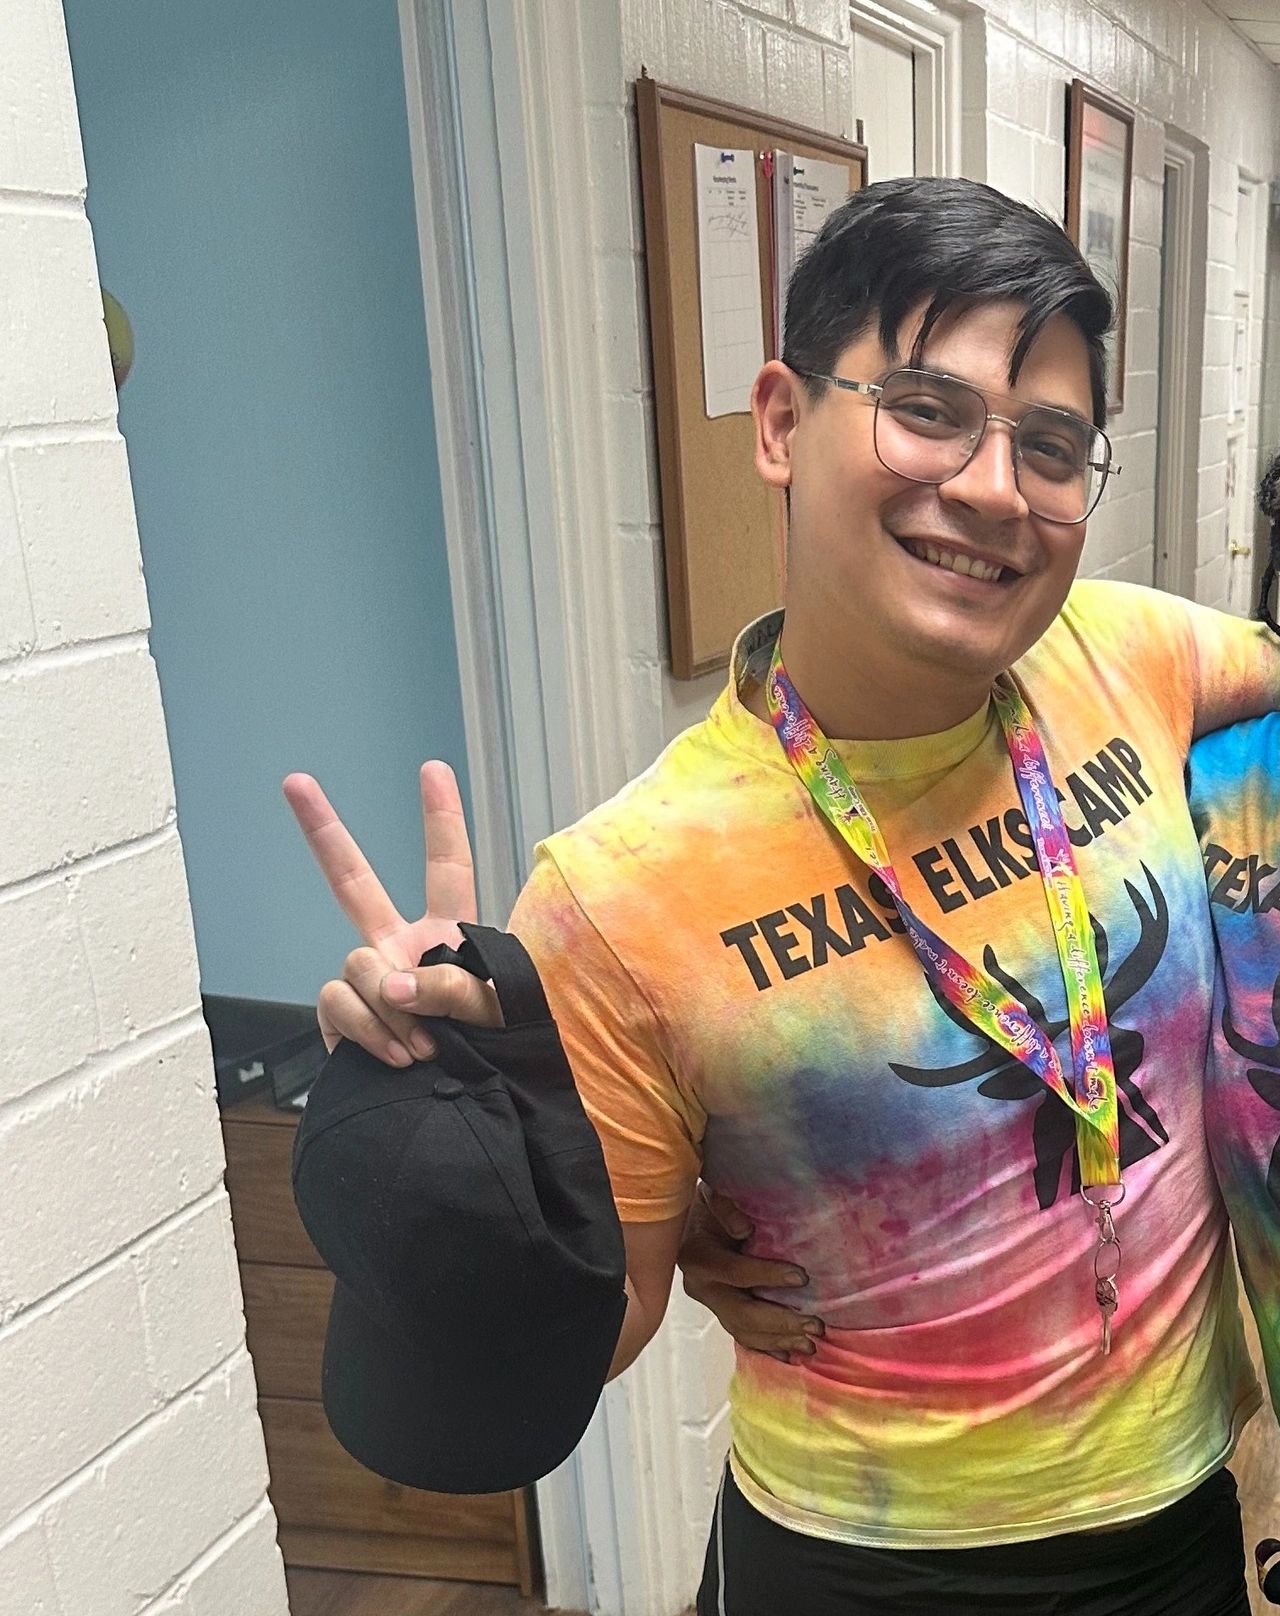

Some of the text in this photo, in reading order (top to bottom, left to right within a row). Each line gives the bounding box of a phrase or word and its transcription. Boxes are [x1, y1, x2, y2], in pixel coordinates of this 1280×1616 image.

[815, 748, 847, 800] Having
[720, 871, 908, 992] TEXAS
[911, 808, 1040, 914] ELKS
[1053, 737, 1153, 848] CAMP
[933, 958, 983, 1005] doesn't
[1057, 881, 1075, 932] Having
[1067, 945, 1091, 1017] difference
[1087, 1076, 1107, 1112] make
[979, 998, 1043, 1056] difference
